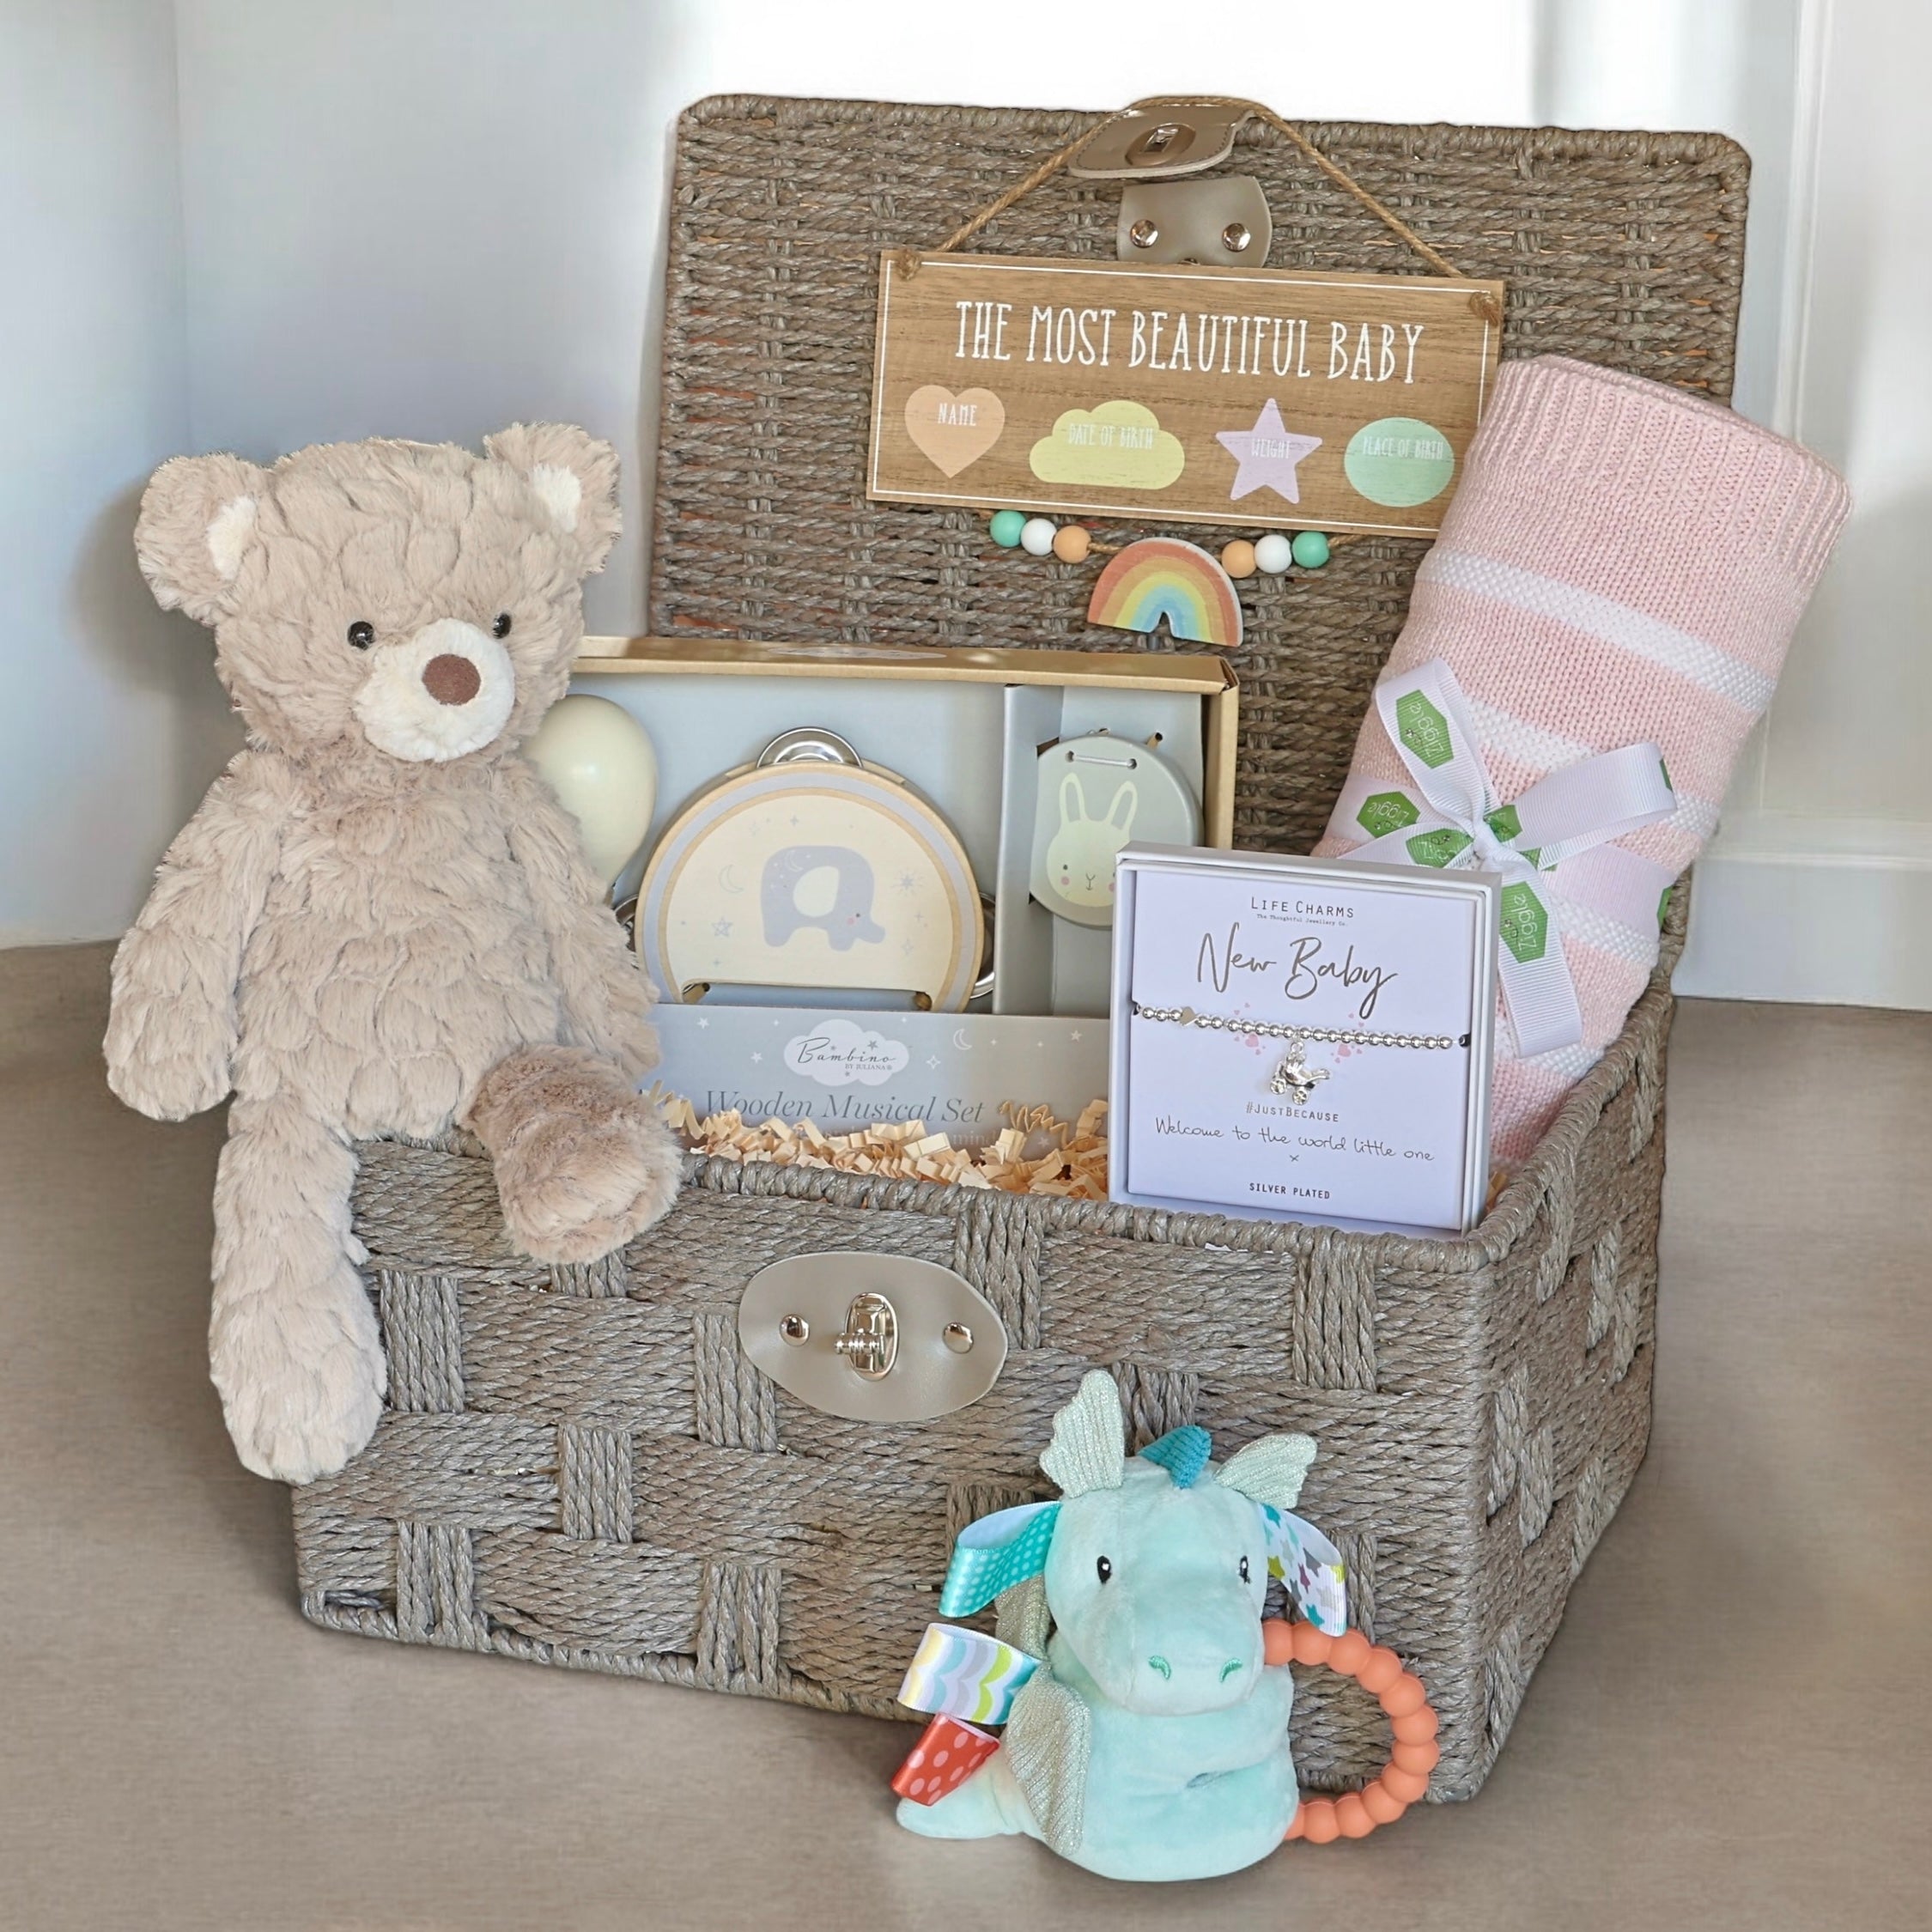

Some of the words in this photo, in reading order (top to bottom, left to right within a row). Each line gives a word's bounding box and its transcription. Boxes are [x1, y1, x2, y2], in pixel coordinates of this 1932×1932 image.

[956, 301, 1012, 361] THE
[1026, 305, 1116, 367] MOST
[1129, 311, 1310, 378] BEAUTIFUL
[1327, 321, 1424, 385] BABY
[937, 402, 977, 427] NAME
[1068, 422, 1096, 446] DATE
[1100, 425, 1115, 446] OF
[1120, 426, 1153, 449] BIRTH
[1251, 438, 1291, 459] WEIGHT
[1363, 435, 1393, 457] PLACE
[1397, 438, 1411, 458] OF
[1415, 440, 1443, 459] BIRTH
[1251, 896, 1289, 912] LIFE
[1296, 900, 1354, 919] CHARMS
[1197, 922, 1277, 993] New
[1285, 937, 1399, 1019] Baby
[797, 1037, 896, 1064] Bambino
[706, 1090, 812, 1117] Wooden
[822, 1095, 937, 1121] Musical
[941, 1097, 986, 1123] Set
[1156, 1116, 1224, 1138] Welcome
[1232, 1125, 1250, 1141] to
[1259, 1127, 1291, 1145] the
[1298, 1136, 1346, 1152] world
[1354, 1137, 1396, 1157] little
[1404, 1150, 1435, 1162] one
[1249, 1182, 1286, 1195] SILVER
[1293, 1187, 1330, 1200] PLATED
